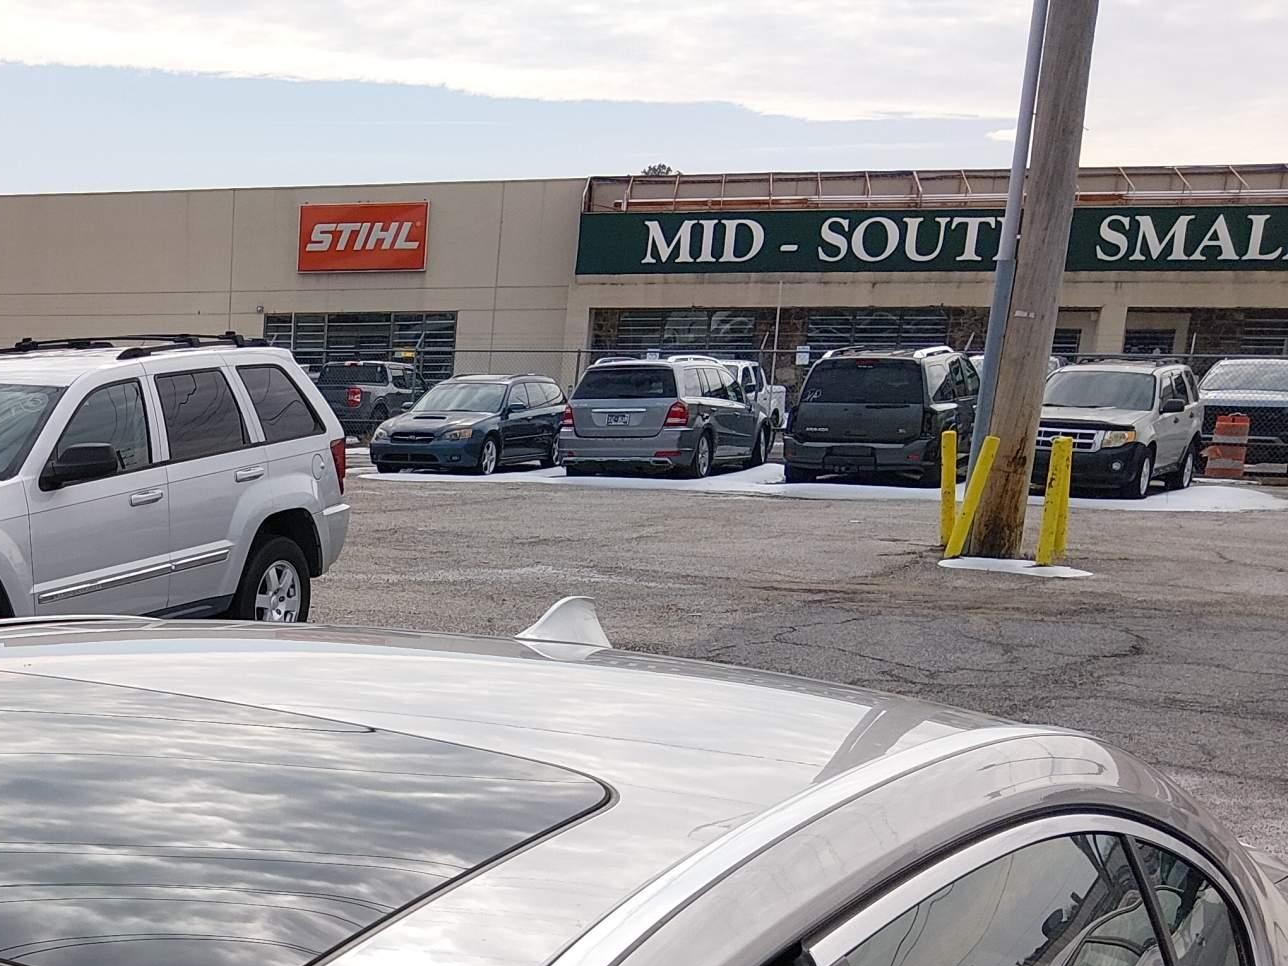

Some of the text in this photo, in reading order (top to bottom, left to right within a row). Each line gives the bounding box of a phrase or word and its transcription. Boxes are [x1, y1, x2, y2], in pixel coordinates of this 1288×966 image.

[305, 221, 420, 252] STIHL
[640, 218, 765, 264] MID
[1095, 213, 1288, 262] SMAL
